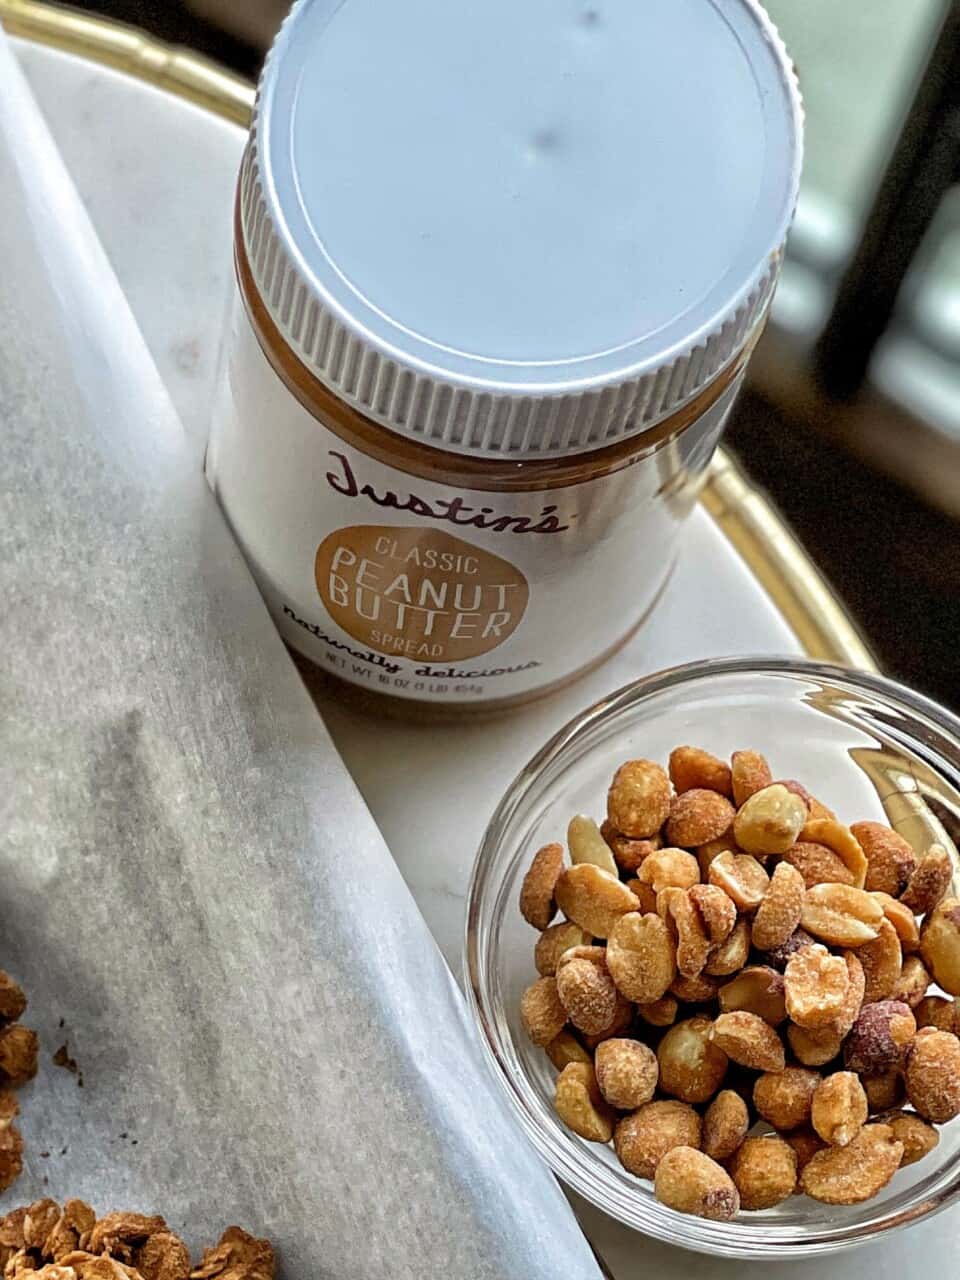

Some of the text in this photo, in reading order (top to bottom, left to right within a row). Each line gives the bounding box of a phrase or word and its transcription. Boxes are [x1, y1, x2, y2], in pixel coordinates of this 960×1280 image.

[326, 450, 568, 534] Justin's
[331, 546, 519, 610] PEANUT
[375, 536, 479, 574] CLASSIC
[329, 572, 511, 640] BUTTER
[283, 604, 542, 678] naturally delicious
[326, 652, 346, 669] NET
[352, 664, 372, 679] WT
[394, 678, 409, 690] OZ
[369, 630, 444, 657] SPREAD
